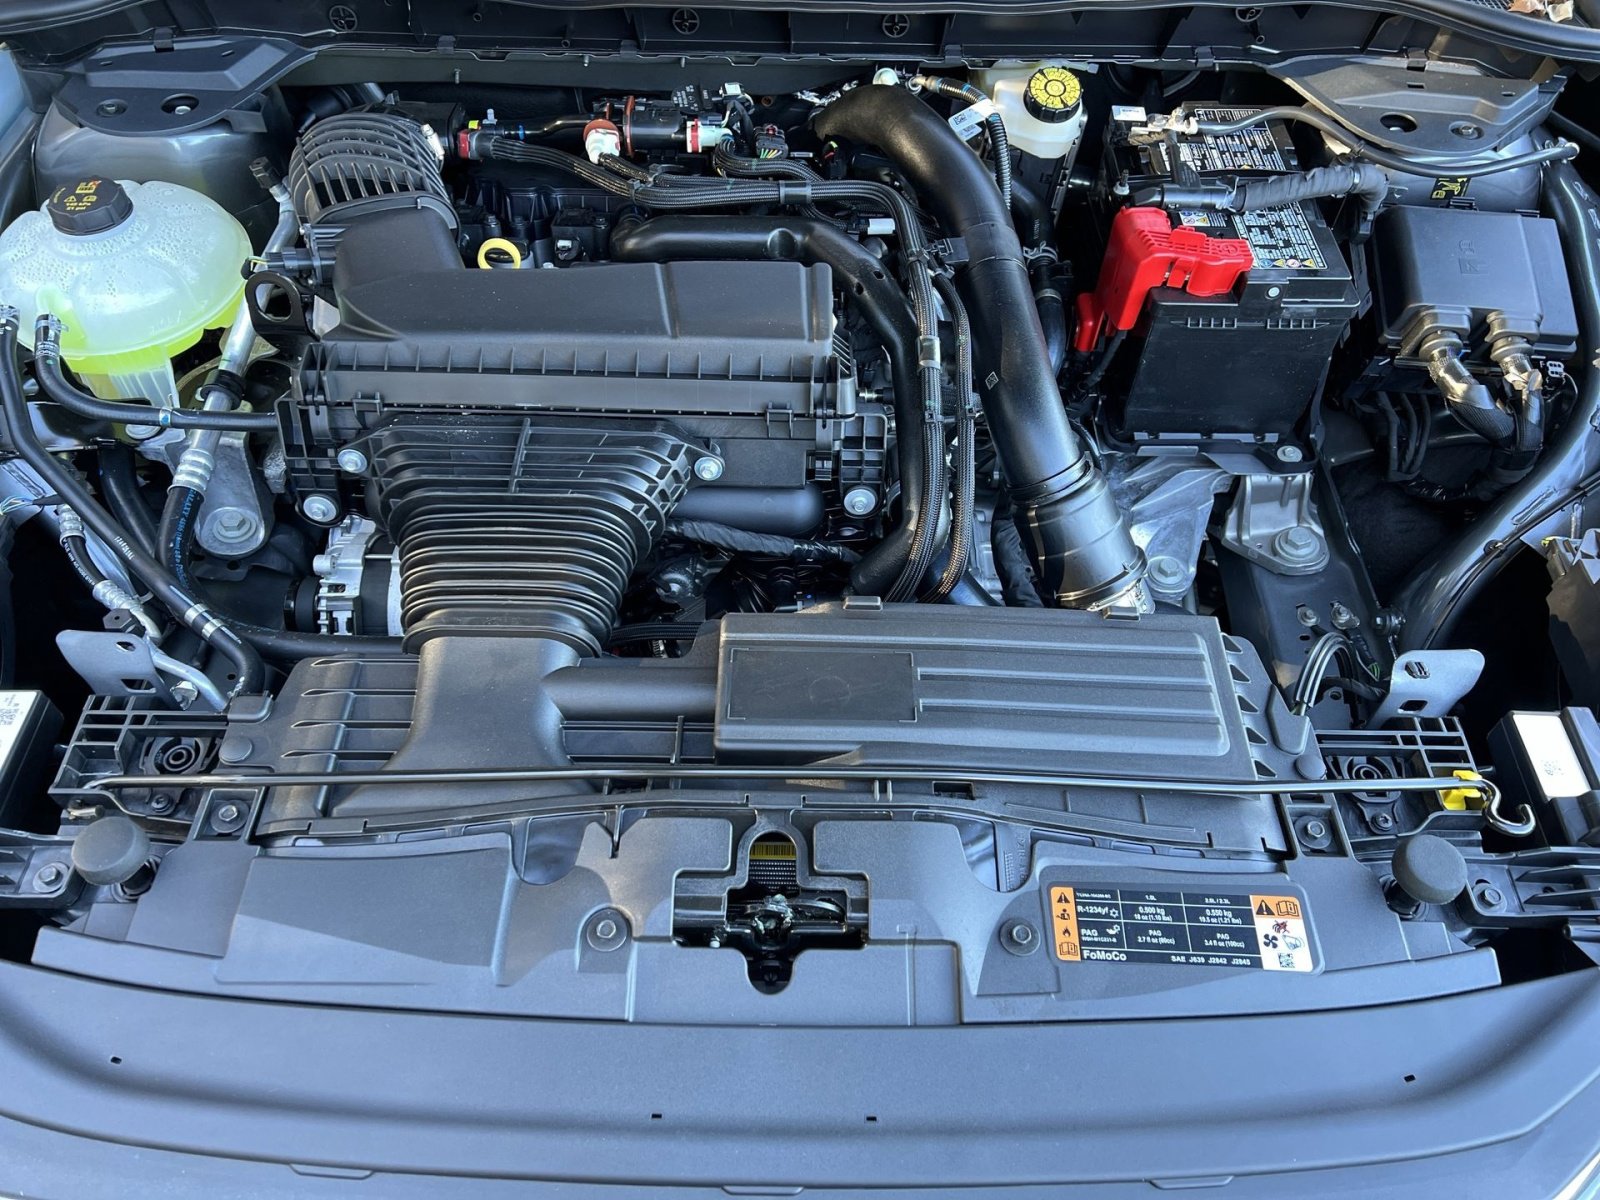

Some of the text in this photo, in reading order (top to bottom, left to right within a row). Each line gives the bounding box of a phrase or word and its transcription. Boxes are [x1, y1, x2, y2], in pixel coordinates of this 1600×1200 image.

[1077, 905, 1109, 915] R-1234yf
[1138, 905, 1165, 916] 0.500 kg
[1205, 908, 1233, 919] 0.550 kg
[1231, 917, 1242, 925] lbs)
[1081, 928, 1099, 937] PAG
[1148, 929, 1162, 937] PAG
[1216, 932, 1230, 940] PAG
[1083, 950, 1127, 961] FoMoCo
[1170, 955, 1187, 963] SAE
